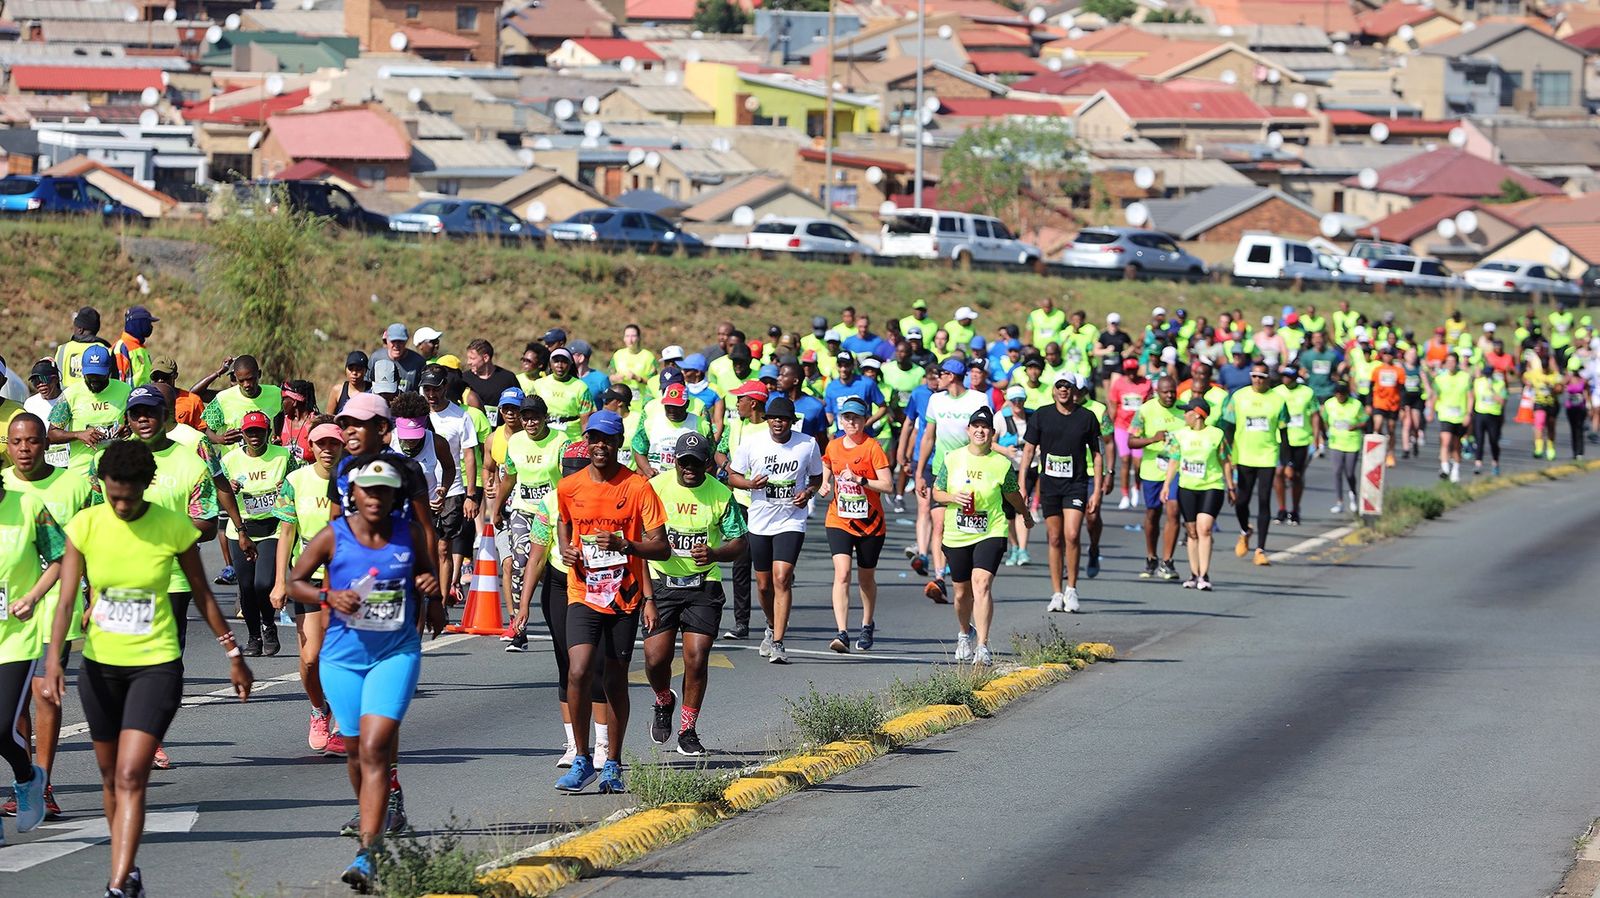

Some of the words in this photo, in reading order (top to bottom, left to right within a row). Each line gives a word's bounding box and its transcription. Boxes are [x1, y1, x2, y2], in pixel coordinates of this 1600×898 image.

[92, 401, 110, 411] WE
[526, 455, 543, 464] WE
[764, 454, 777, 464] THE
[765, 460, 799, 475] GRIND
[249, 471, 267, 481] WE
[966, 470, 983, 480] WE
[316, 496, 329, 508] W
[845, 500, 868, 513] 14344
[676, 502, 698, 515] WE
[963, 515, 988, 528] 16236
[678, 534, 707, 550] 16167
[108, 600, 151, 623] 20912
